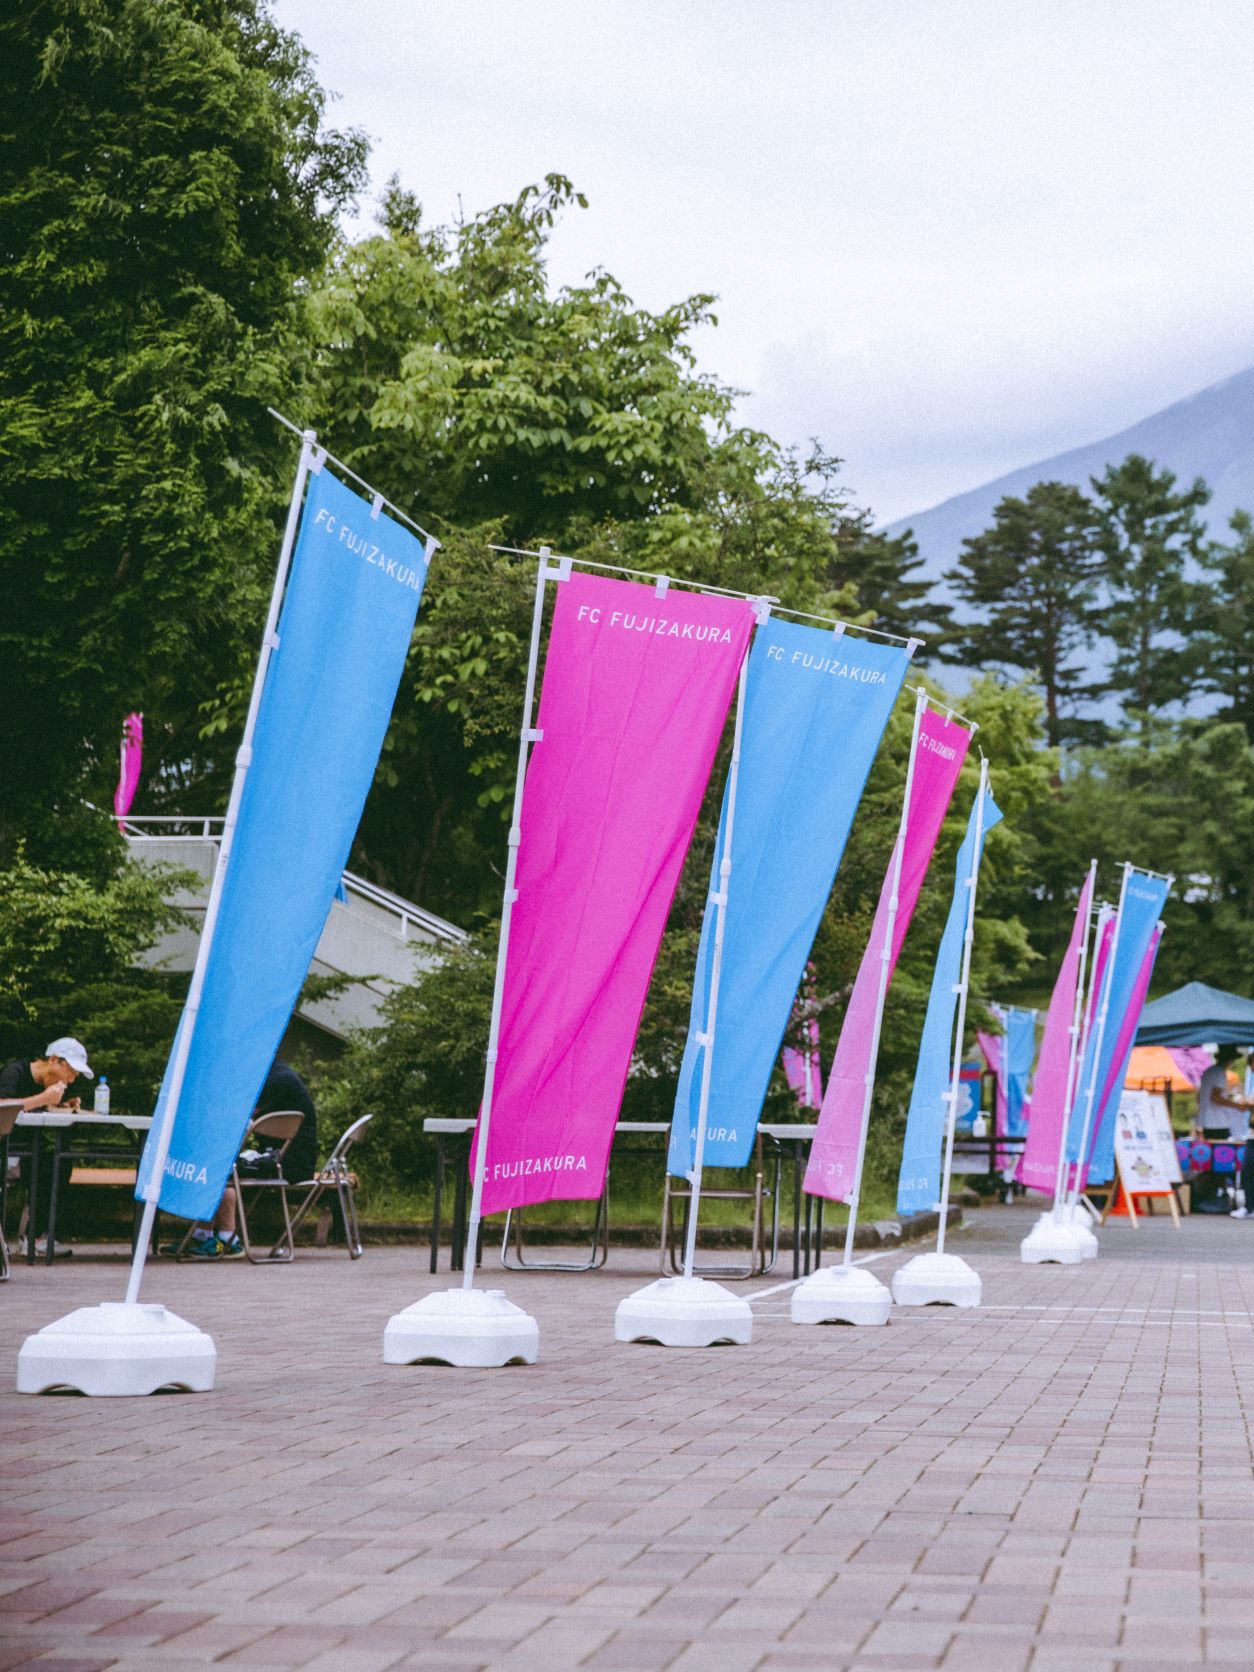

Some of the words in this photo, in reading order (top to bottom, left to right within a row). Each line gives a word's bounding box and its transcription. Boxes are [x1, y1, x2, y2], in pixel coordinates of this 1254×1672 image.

[314, 508, 336, 533] FC
[339, 525, 420, 593] FUJIZAKURA
[577, 605, 601, 624] FC
[610, 611, 732, 644] FUJIZAKURA
[766, 645, 785, 661] FC
[791, 651, 887, 685] FUJIZAKURA
[919, 731, 929, 747] FC
[494, 1155, 588, 1181] FUJIZAKURA
